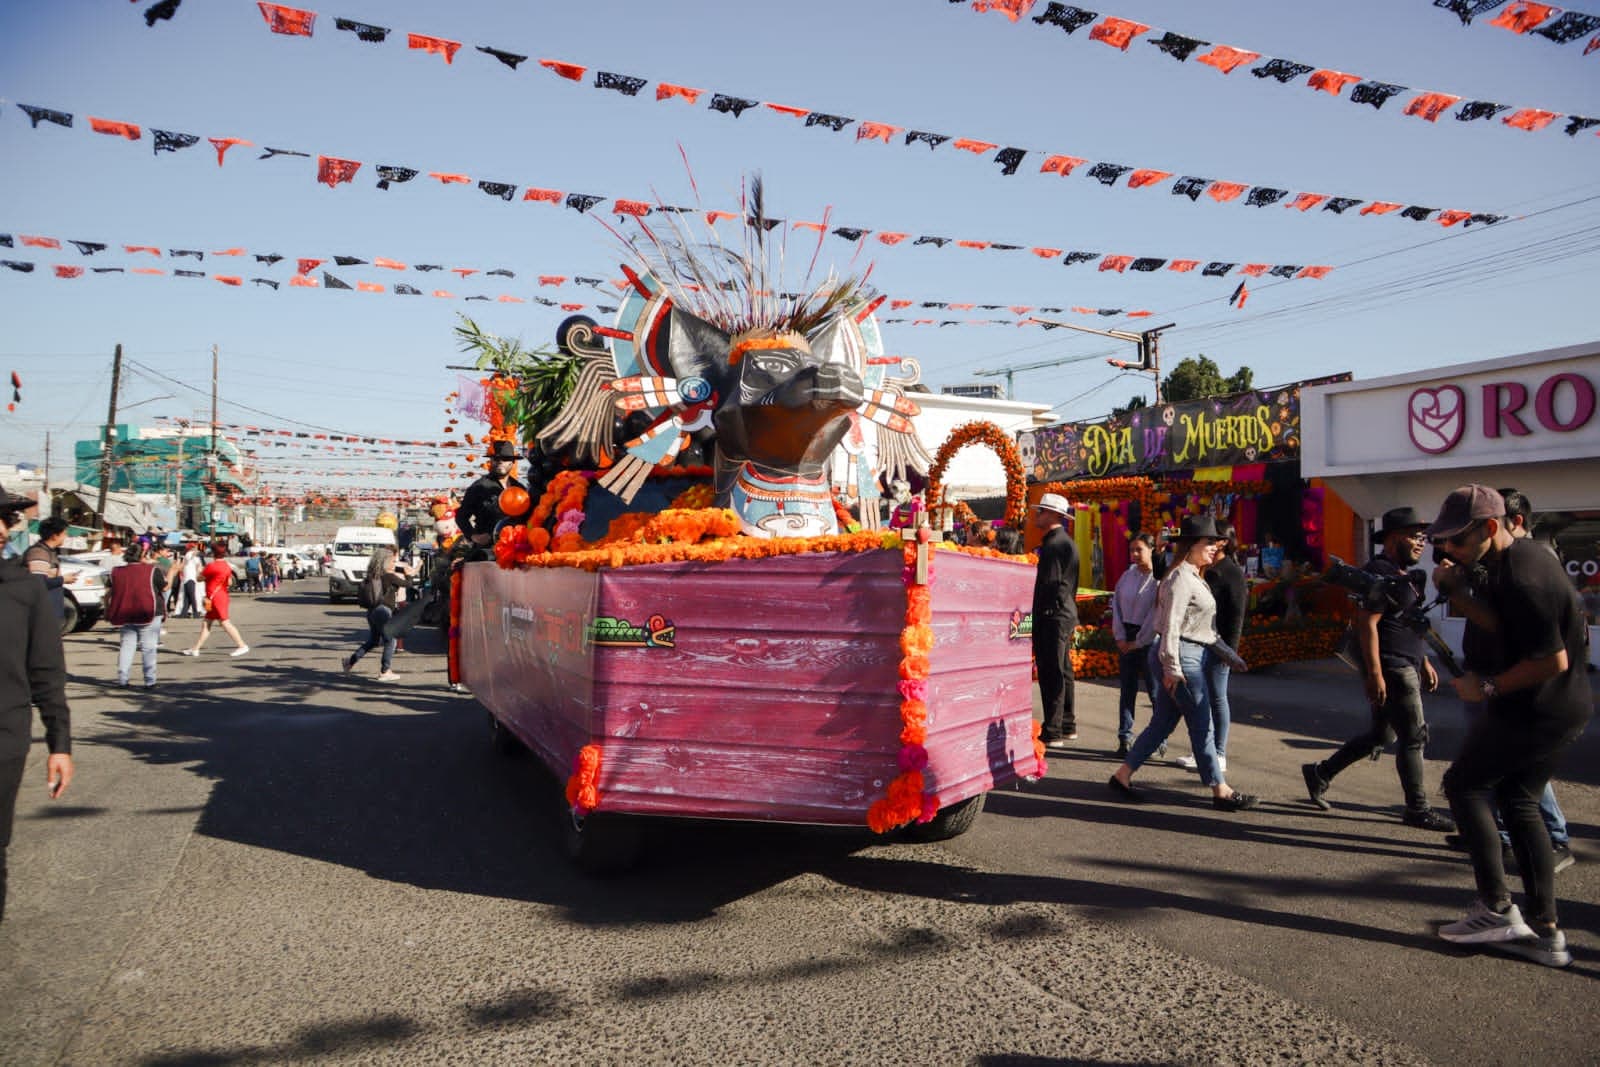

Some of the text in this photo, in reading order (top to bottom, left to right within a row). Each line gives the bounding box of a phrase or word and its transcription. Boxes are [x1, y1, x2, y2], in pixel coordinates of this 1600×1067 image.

[1144, 426, 1168, 459] DE
[1174, 405, 1274, 463] MUERTOS
[1482, 373, 1597, 438] RO
[1565, 560, 1599, 576] CO
